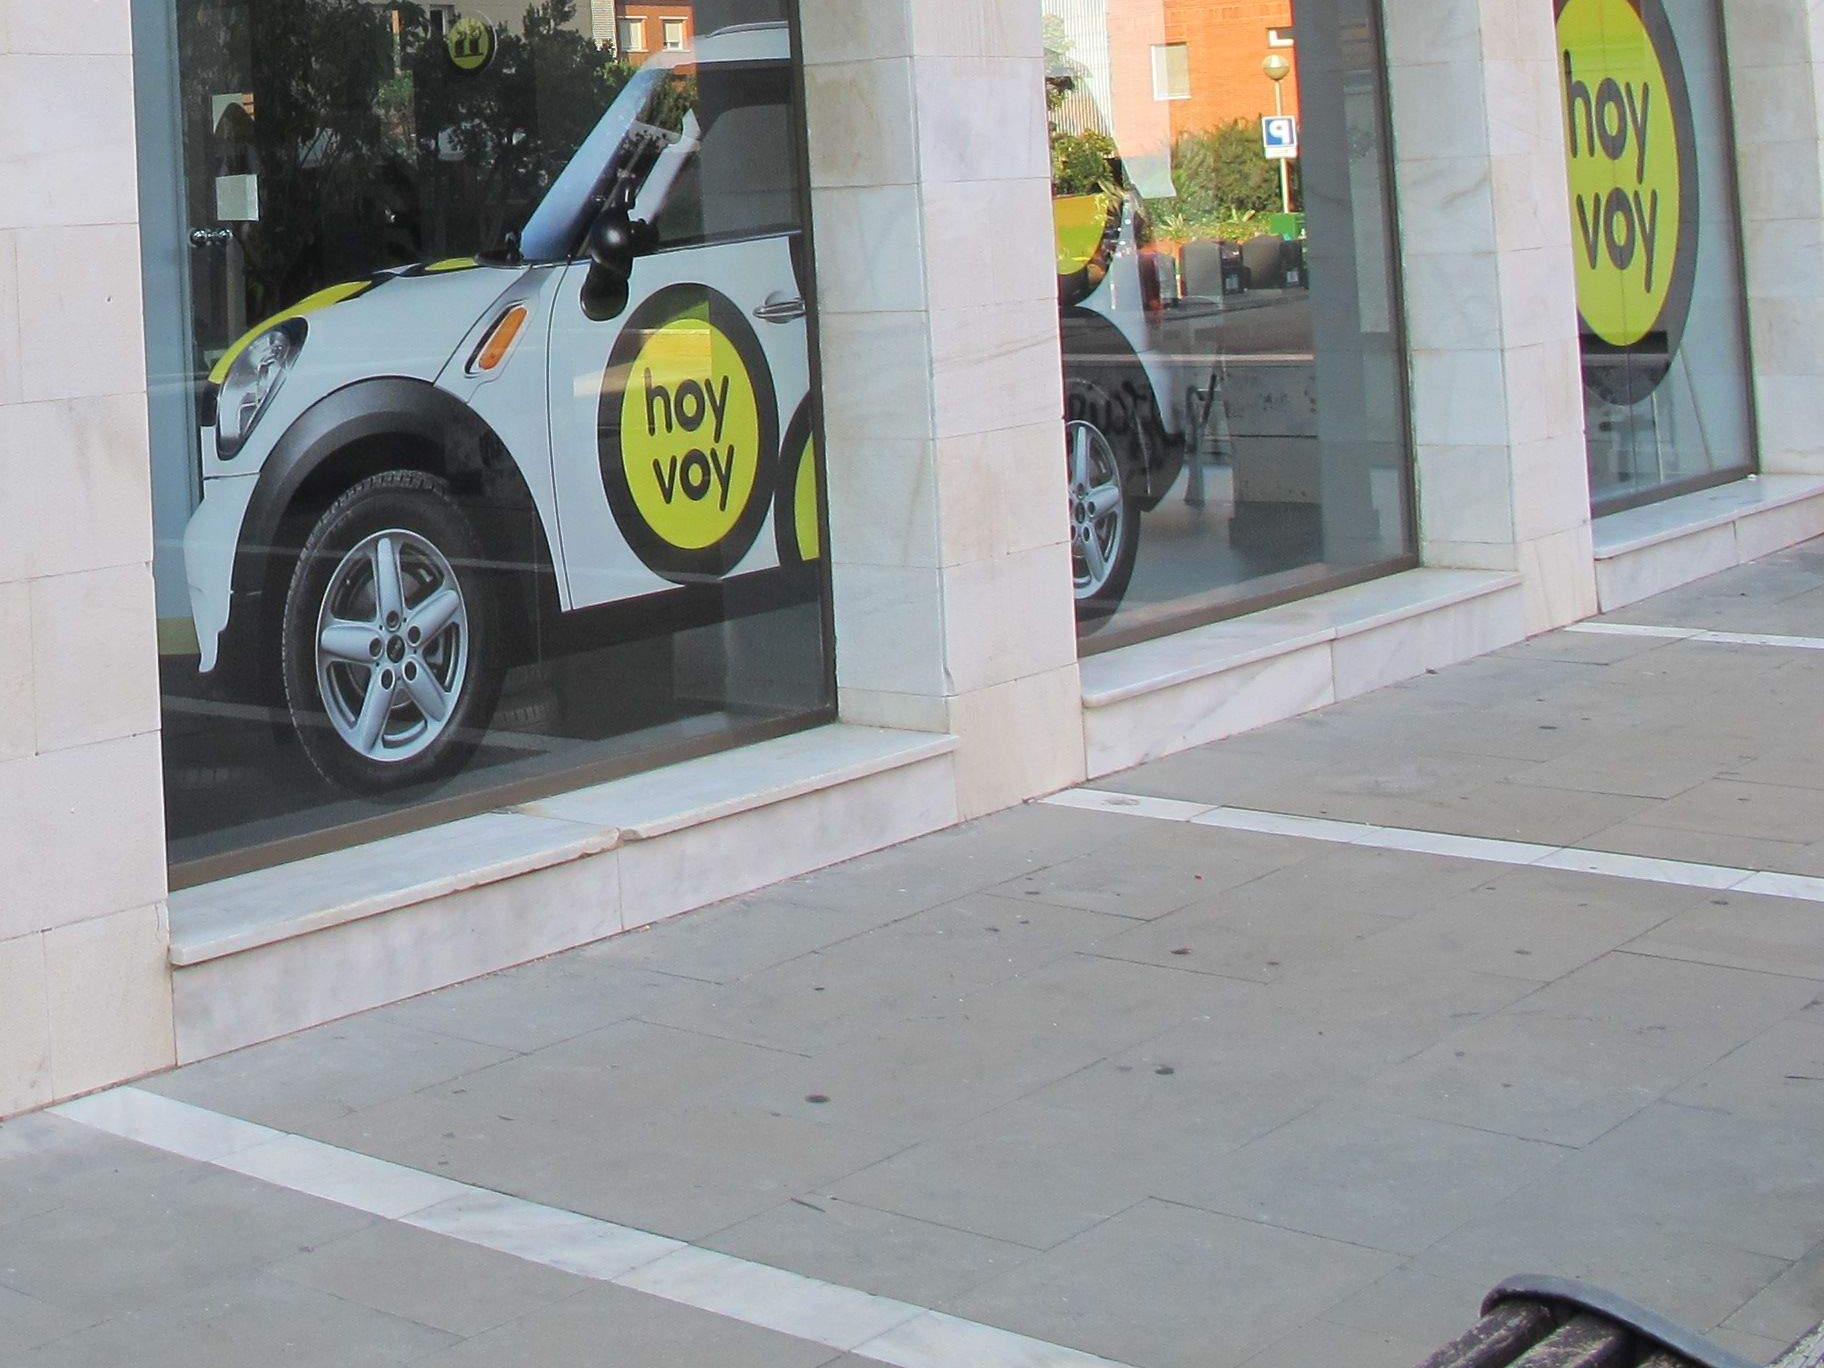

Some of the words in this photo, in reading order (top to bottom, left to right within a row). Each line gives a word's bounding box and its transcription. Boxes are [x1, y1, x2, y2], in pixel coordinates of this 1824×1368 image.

[1563, 48, 1649, 185] hoy
[1576, 187, 1658, 293] voy
[644, 367, 729, 443] hoy
[652, 444, 735, 512] voy
